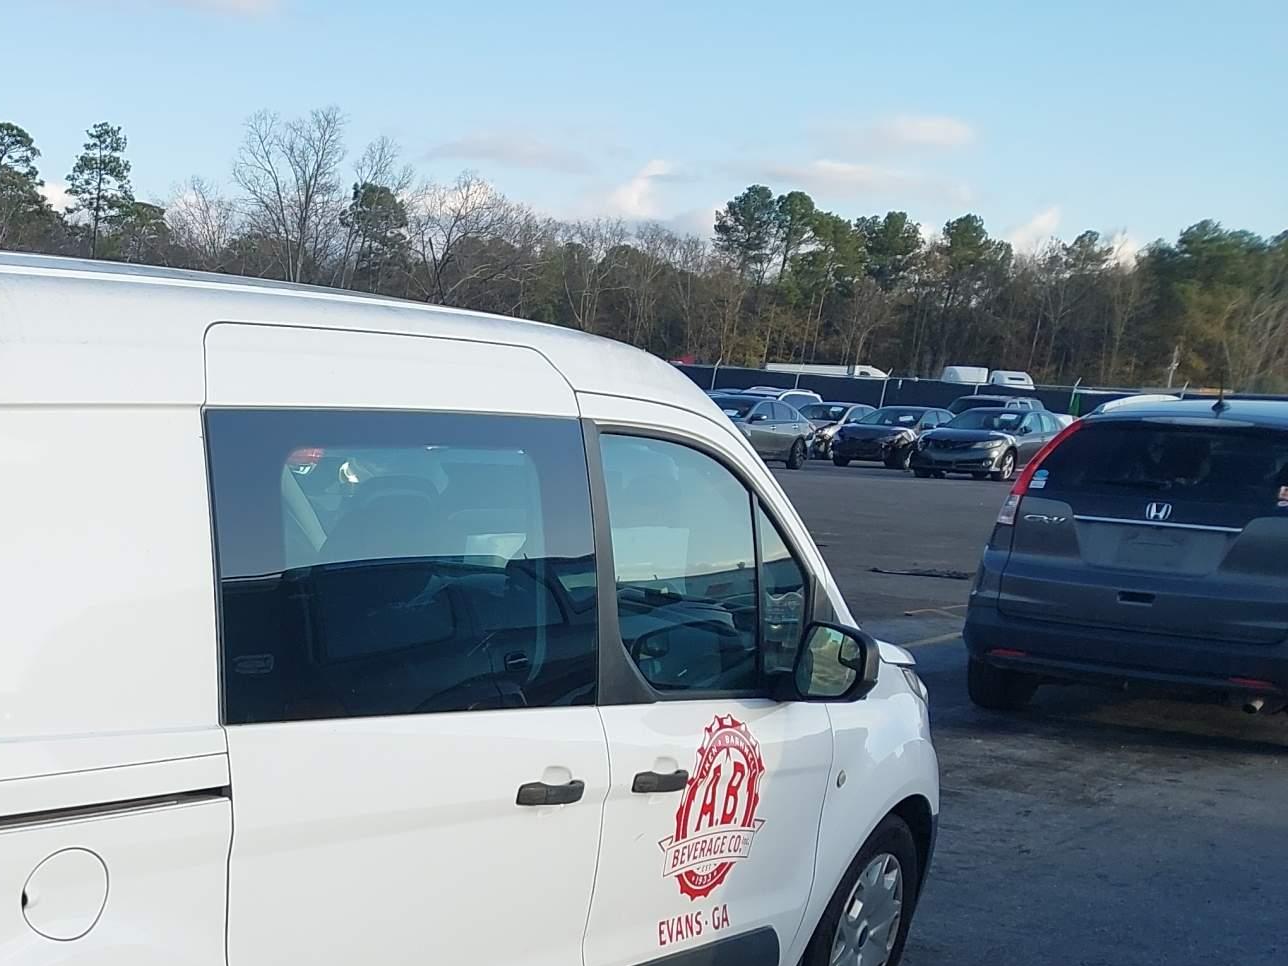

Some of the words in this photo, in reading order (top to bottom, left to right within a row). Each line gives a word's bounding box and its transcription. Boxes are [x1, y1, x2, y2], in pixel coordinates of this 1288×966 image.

[672, 835, 727, 868] BEVERAGE
[728, 835, 742, 853] CO.
[658, 911, 703, 946] EVANS
[712, 904, 730, 930] GA
